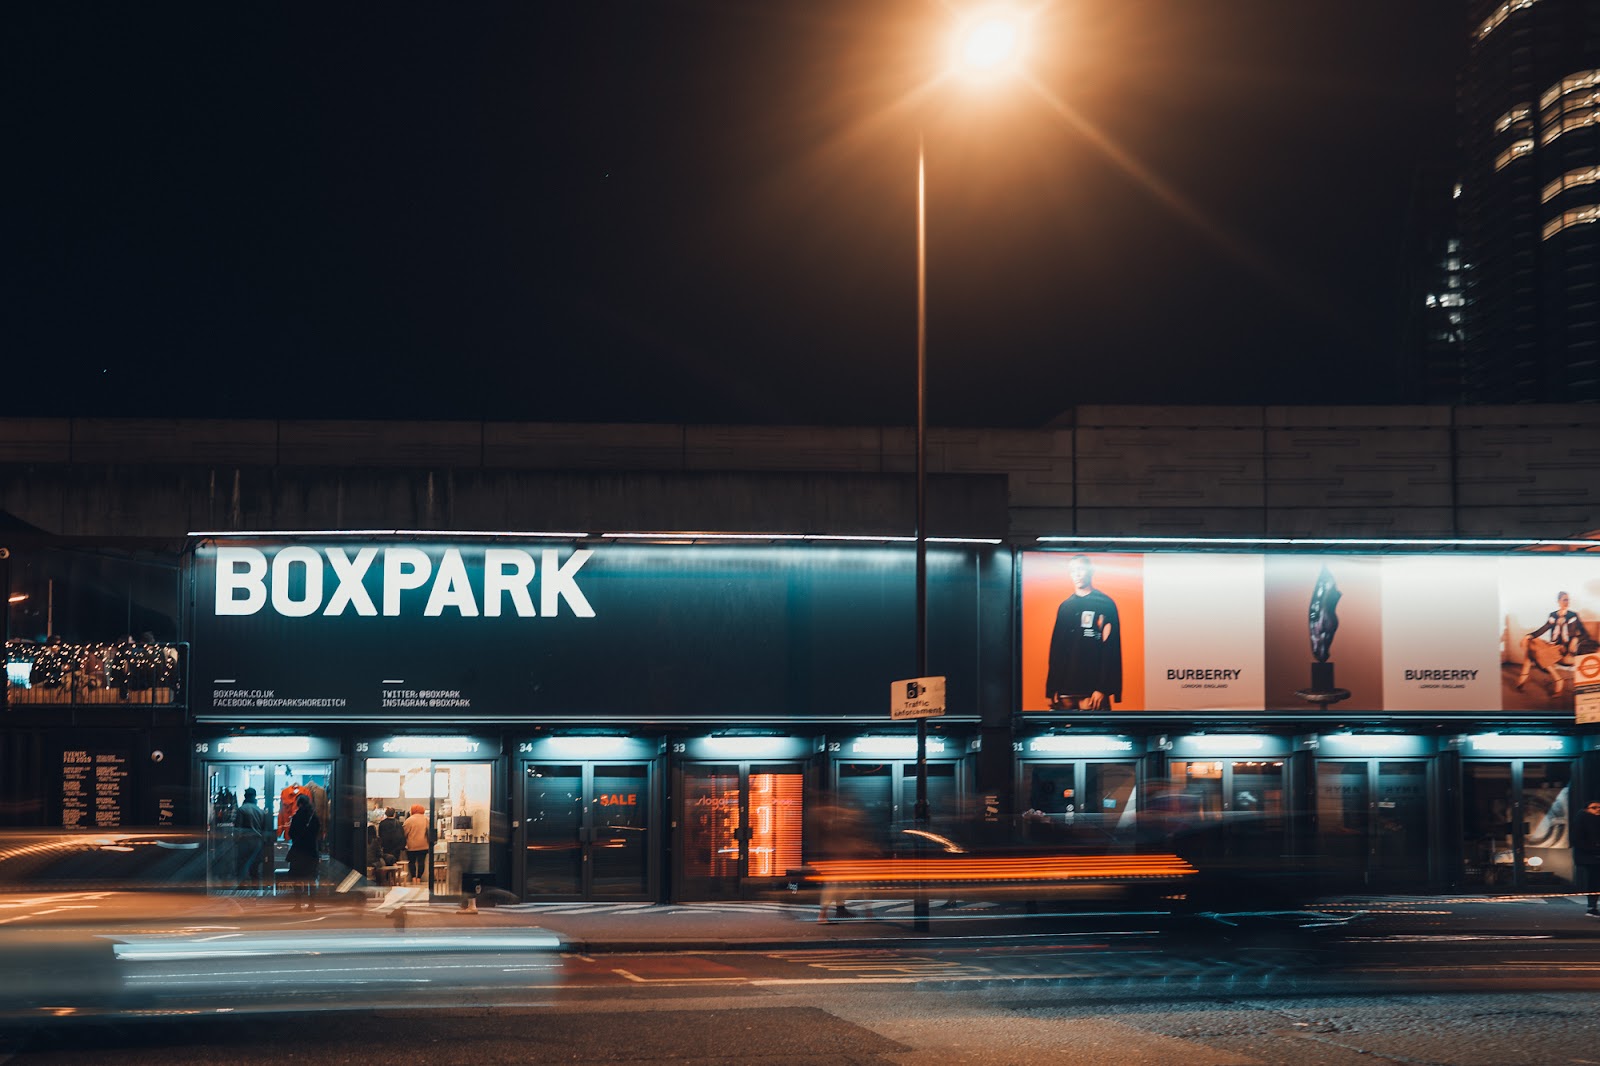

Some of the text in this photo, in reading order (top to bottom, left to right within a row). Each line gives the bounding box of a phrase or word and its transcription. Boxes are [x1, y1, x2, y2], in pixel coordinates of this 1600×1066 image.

[215, 546, 597, 618] BOXPARK
[1167, 669, 1242, 680] BURBERRY
[1405, 669, 1479, 681] BURBERRY
[213, 690, 275, 698] BOXPARK.CO.UK
[382, 690, 460, 698] TWITTER: @BOXPARK
[213, 699, 346, 707] FACEBOOK: @BOXPARKSHOREDITCH
[382, 699, 470, 707] INSTAGRAM: @BOXPARK
[904, 700, 930, 708] Traffic
[195, 743, 209, 753] 36
[356, 743, 369, 752] 35
[519, 743, 533, 753] 34
[673, 743, 686, 753] 33
[828, 742, 841, 752] 32
[1012, 742, 1024, 751] 31
[600, 794, 636, 806] SALE
